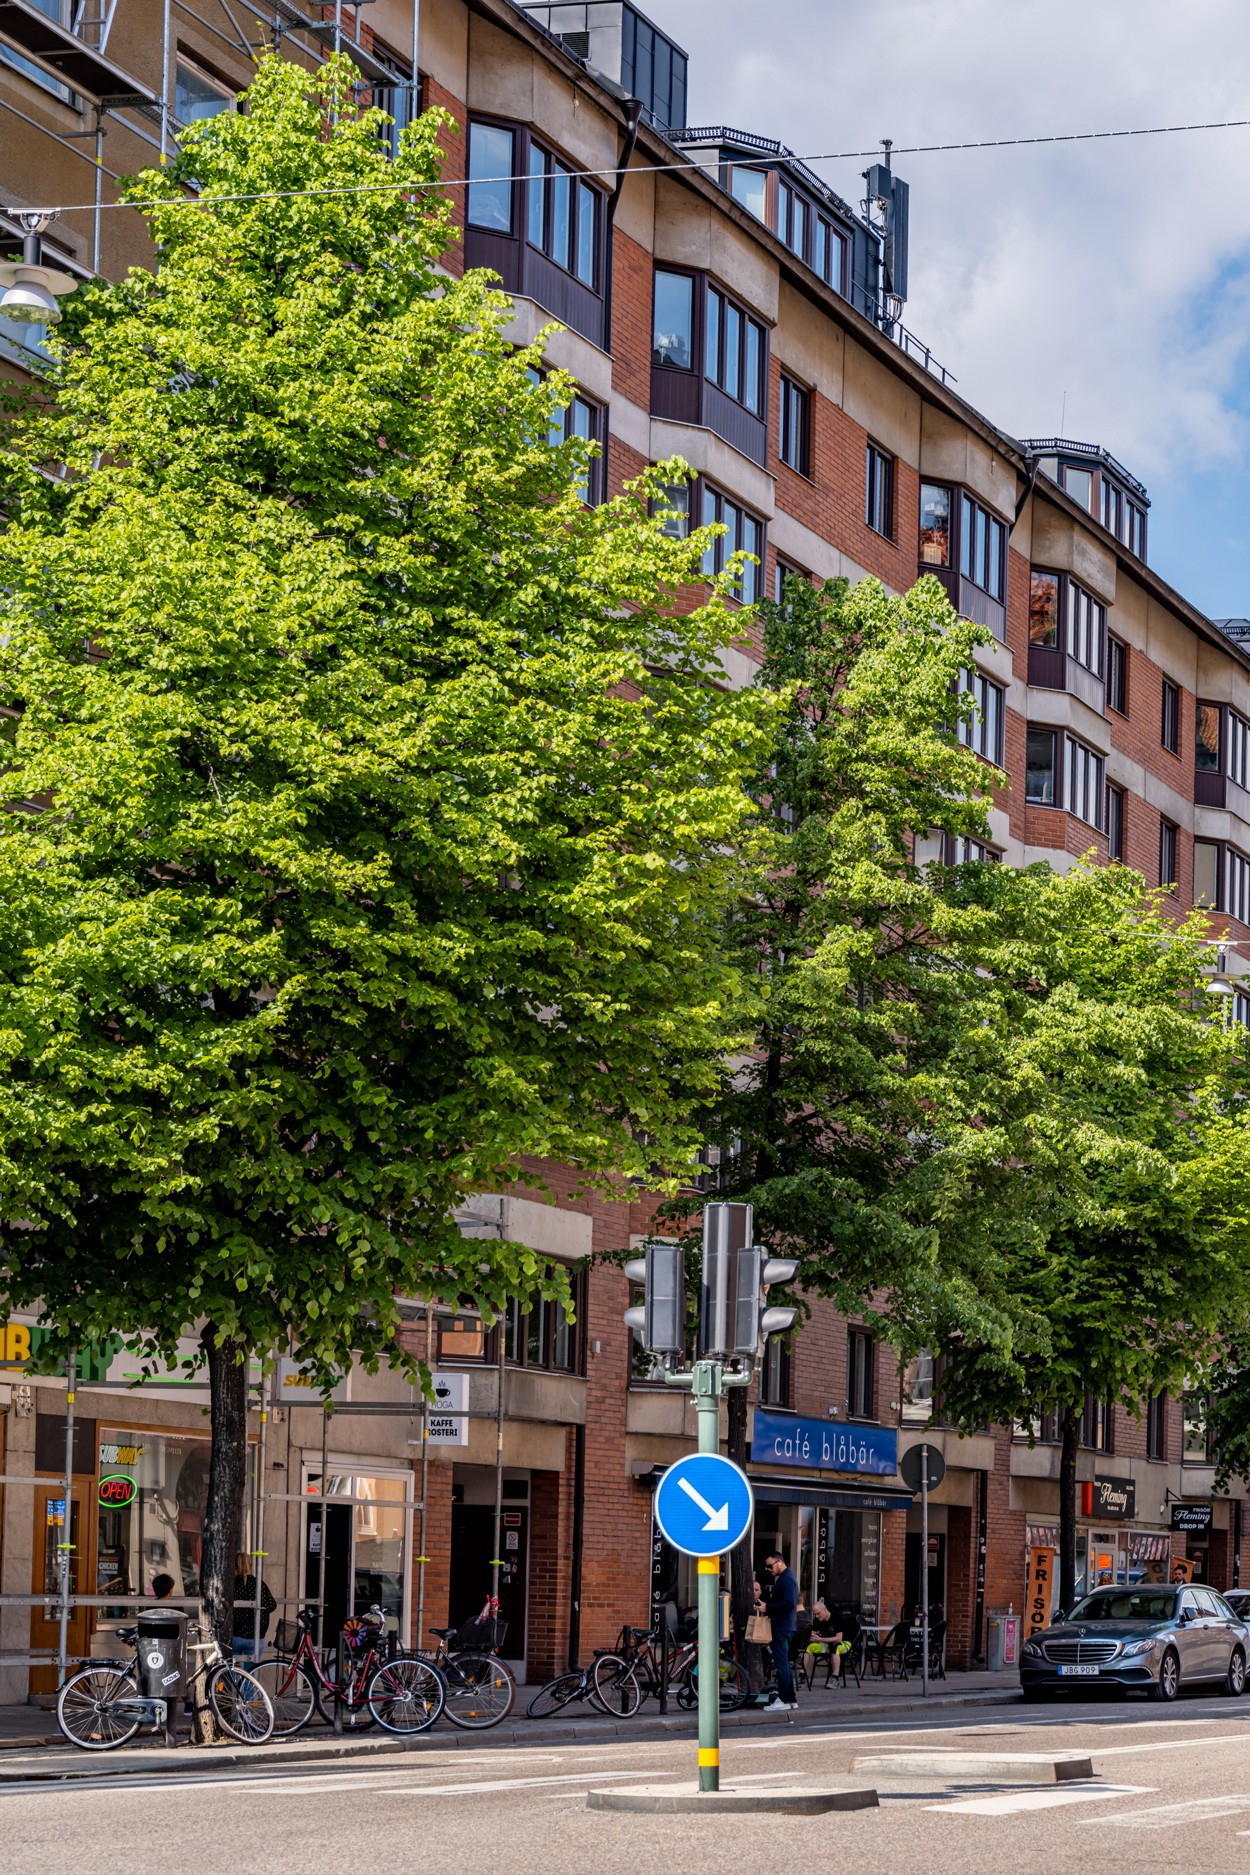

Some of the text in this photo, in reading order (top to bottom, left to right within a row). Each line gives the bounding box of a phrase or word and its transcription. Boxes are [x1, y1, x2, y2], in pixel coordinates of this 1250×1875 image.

[430, 1419, 453, 1427] KAFFE
[774, 1429, 874, 1465] café blåbär
[101, 1481, 132, 1500] OPEN
[1100, 1482, 1128, 1512] Fleming
[1174, 1509, 1211, 1524] Fleming
[1031, 1554, 1048, 1636] FRISÖR
[1064, 1666, 1096, 1674] JBG 909
